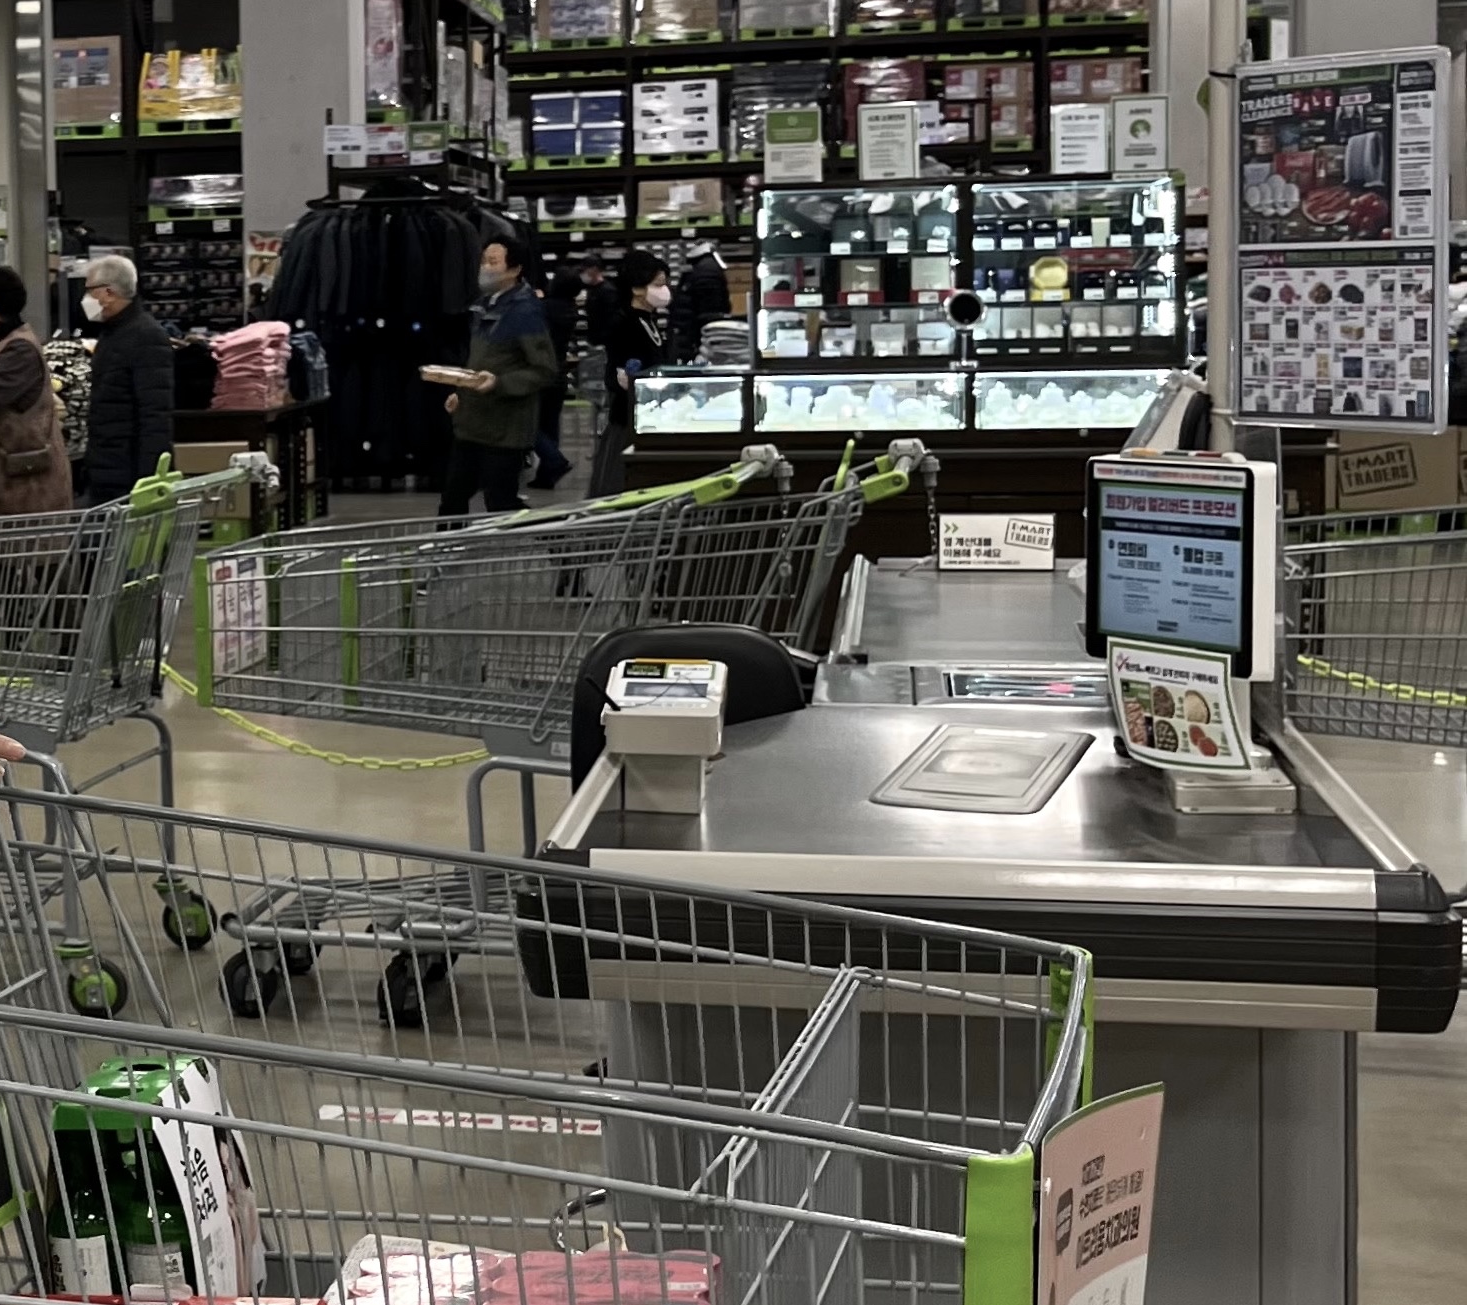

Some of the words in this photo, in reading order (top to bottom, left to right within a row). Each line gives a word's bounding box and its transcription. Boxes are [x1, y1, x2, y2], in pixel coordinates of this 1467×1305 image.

[1241, 94, 1293, 113] TRADERS
[1344, 465, 1409, 487] TRADERS
[1010, 532, 1050, 546] TRADERS
[944, 549, 971, 557] 이용해
[974, 548, 1001, 558] 주세요
